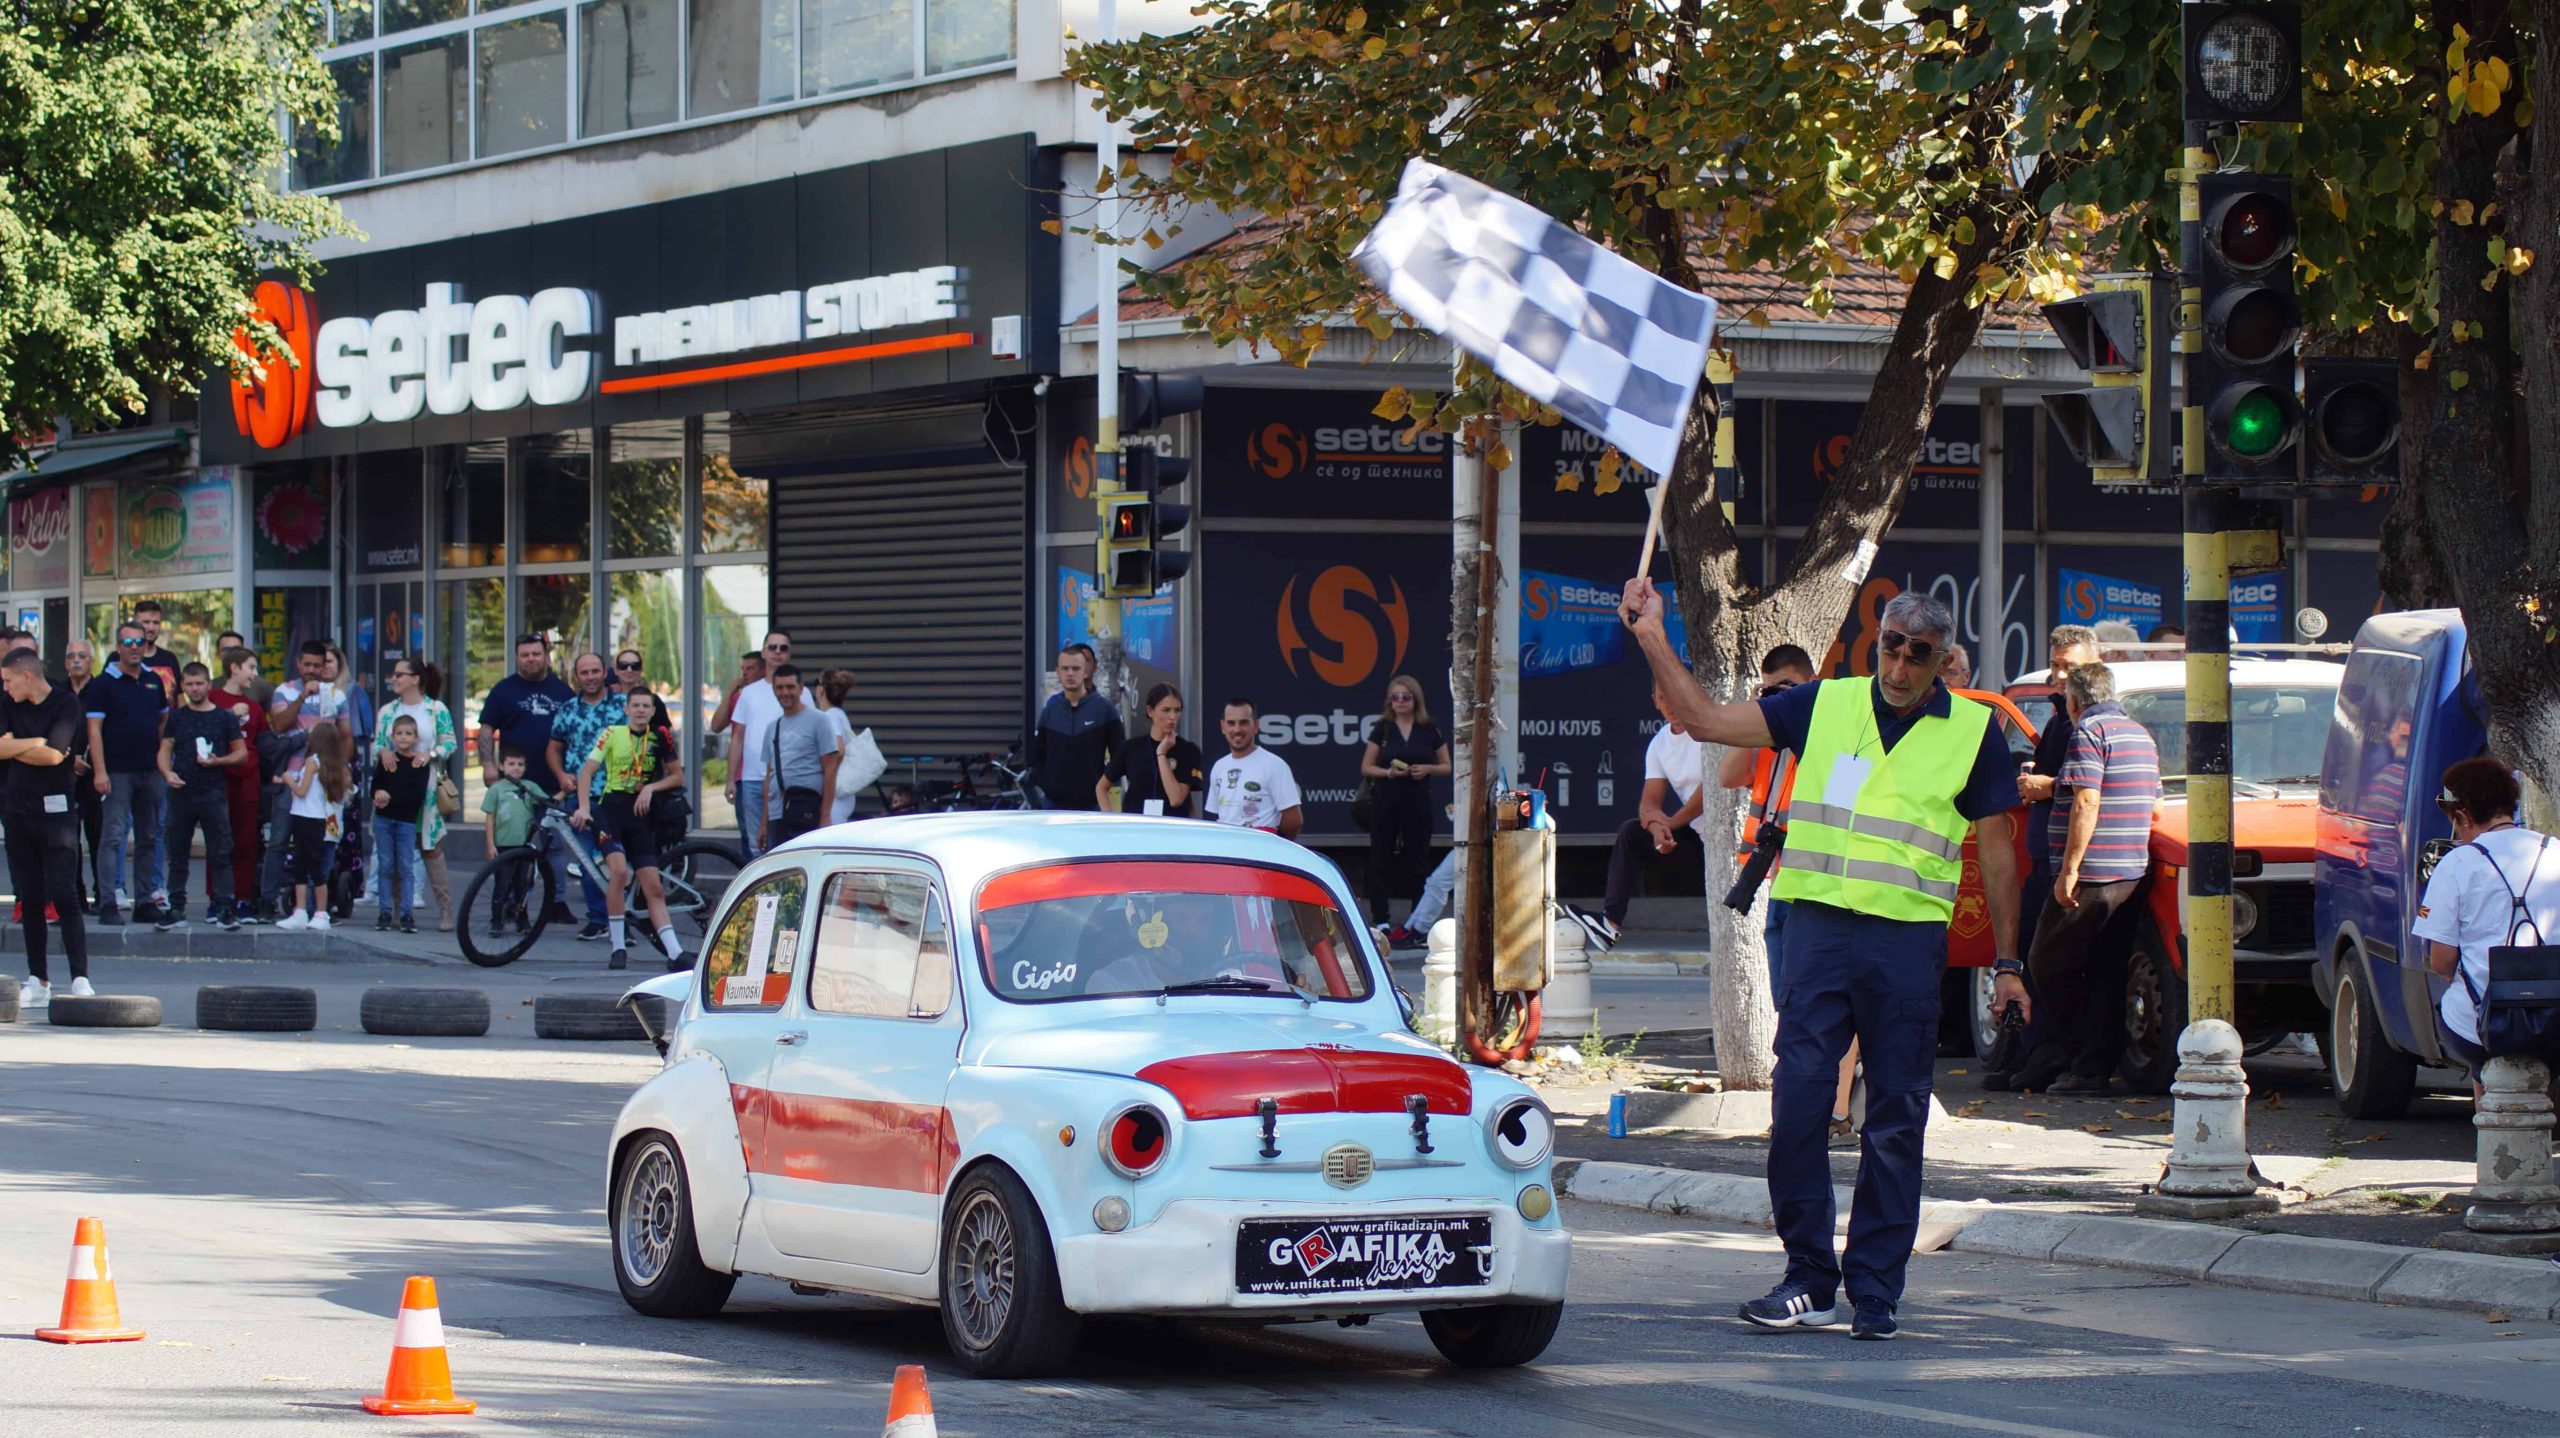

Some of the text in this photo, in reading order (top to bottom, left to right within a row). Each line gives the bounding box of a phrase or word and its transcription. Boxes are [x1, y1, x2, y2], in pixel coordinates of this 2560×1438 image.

[316, 281, 593, 428] setec
[805, 265, 958, 340] STORE
[1314, 424, 1445, 453] setec
[1560, 585, 1622, 607] setec
[2106, 585, 2162, 607] setec
[2231, 584, 2278, 604] tec
[1520, 720, 1602, 737] МОЈ КЛУБ
[780, 938, 794, 965] 04
[1012, 959, 1077, 990] Gigio
[725, 980, 761, 1000] Naumoski
[1330, 1219, 1469, 1234] www.grafikadizajn.mk
[1269, 1233, 1446, 1277] GRAFIKA
[1366, 1250, 1456, 1285] design
[1250, 1277, 1365, 1292] www.unikat.mk
